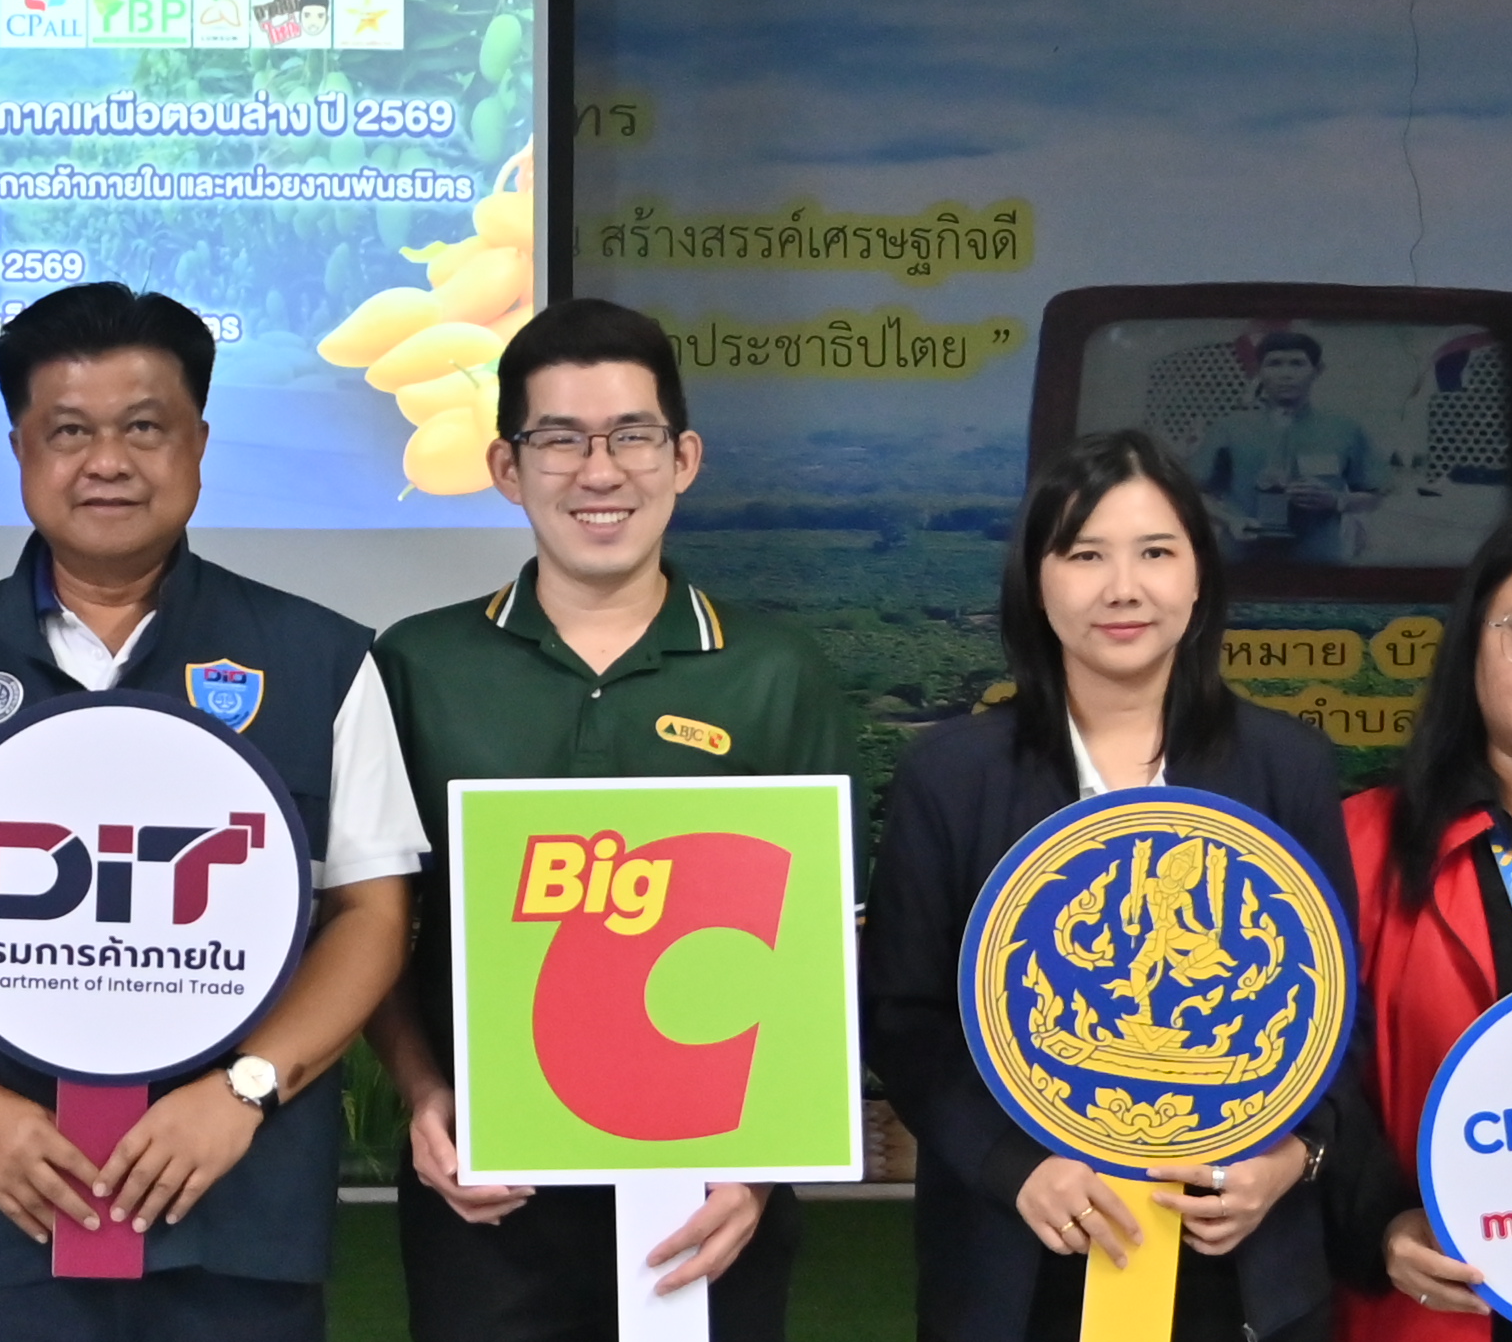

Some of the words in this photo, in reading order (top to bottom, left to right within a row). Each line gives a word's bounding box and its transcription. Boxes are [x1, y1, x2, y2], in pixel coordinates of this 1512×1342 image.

[319, 92, 347, 133] ปี
[355, 98, 454, 134] 2569
[179, 166, 472, 200] และหน่วยงานพันธมิตร
[601, 206, 1018, 276] สร้างสรรค์เศรษฐกิจดี
[2, 251, 83, 281] 2569
[679, 724, 705, 742] BJC
[520, 837, 673, 937] Big
[84, 975, 103, 992] of
[107, 977, 183, 994] Internal
[188, 978, 245, 996] Trade
[531, 831, 793, 1142] C
